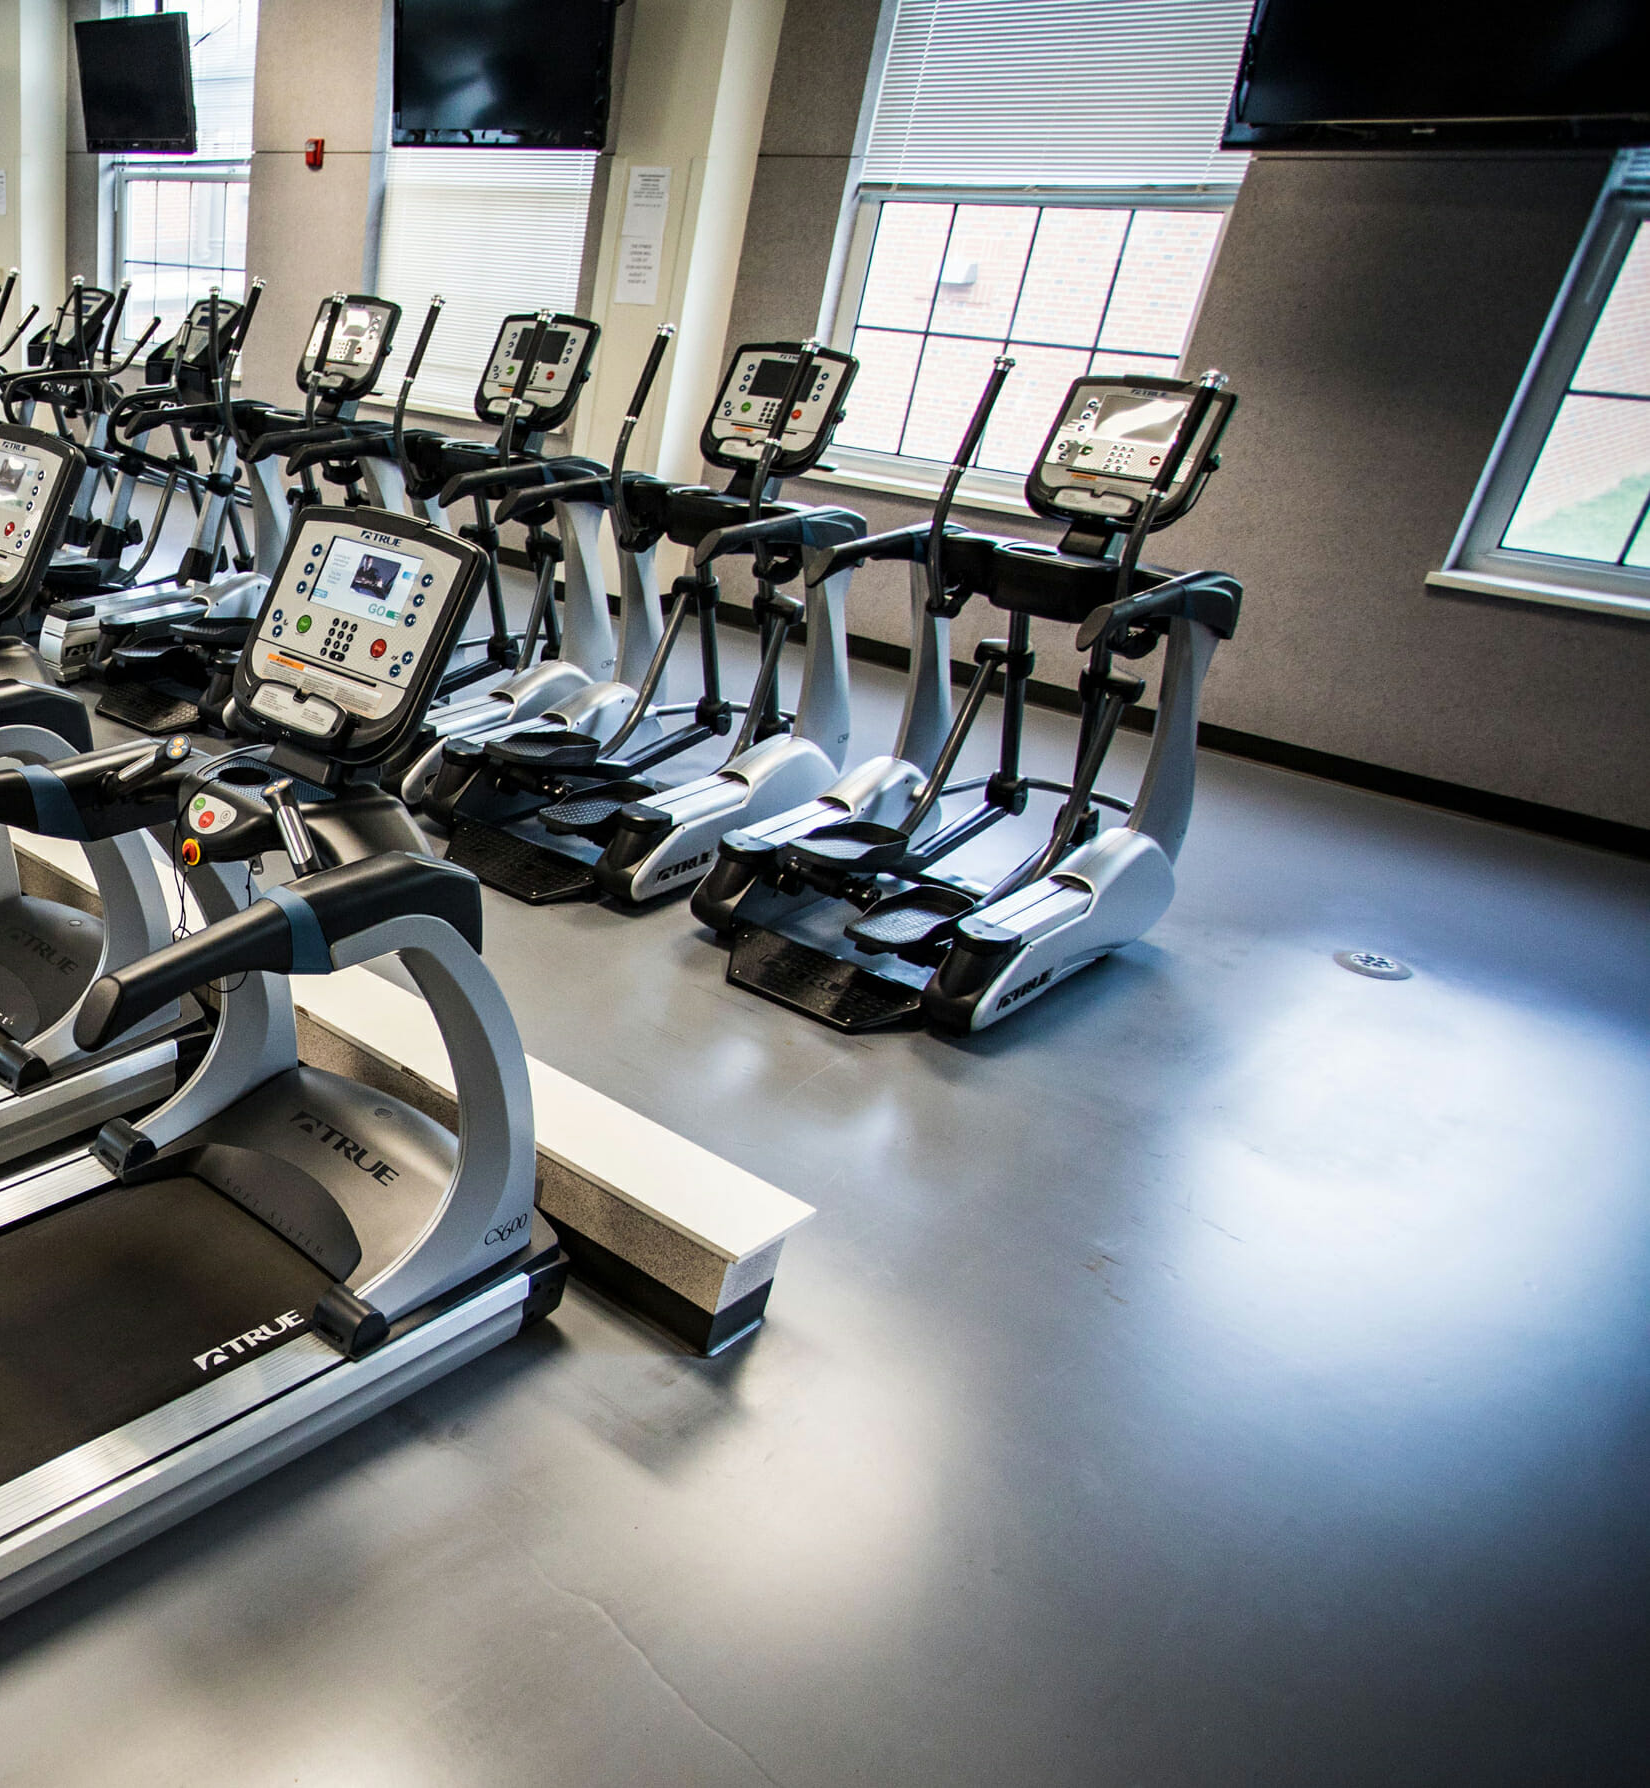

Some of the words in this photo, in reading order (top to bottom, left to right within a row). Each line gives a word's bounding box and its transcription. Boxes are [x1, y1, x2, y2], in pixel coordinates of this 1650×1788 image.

[372, 533, 402, 548] TRUE
[368, 603, 386, 617] GO
[1013, 966, 1055, 1001] TRUE
[319, 1124, 400, 1187] TRUE
[269, 1211, 325, 1255] SYSTEM
[484, 1212, 528, 1246] CS600
[220, 1309, 305, 1354] TRUE
